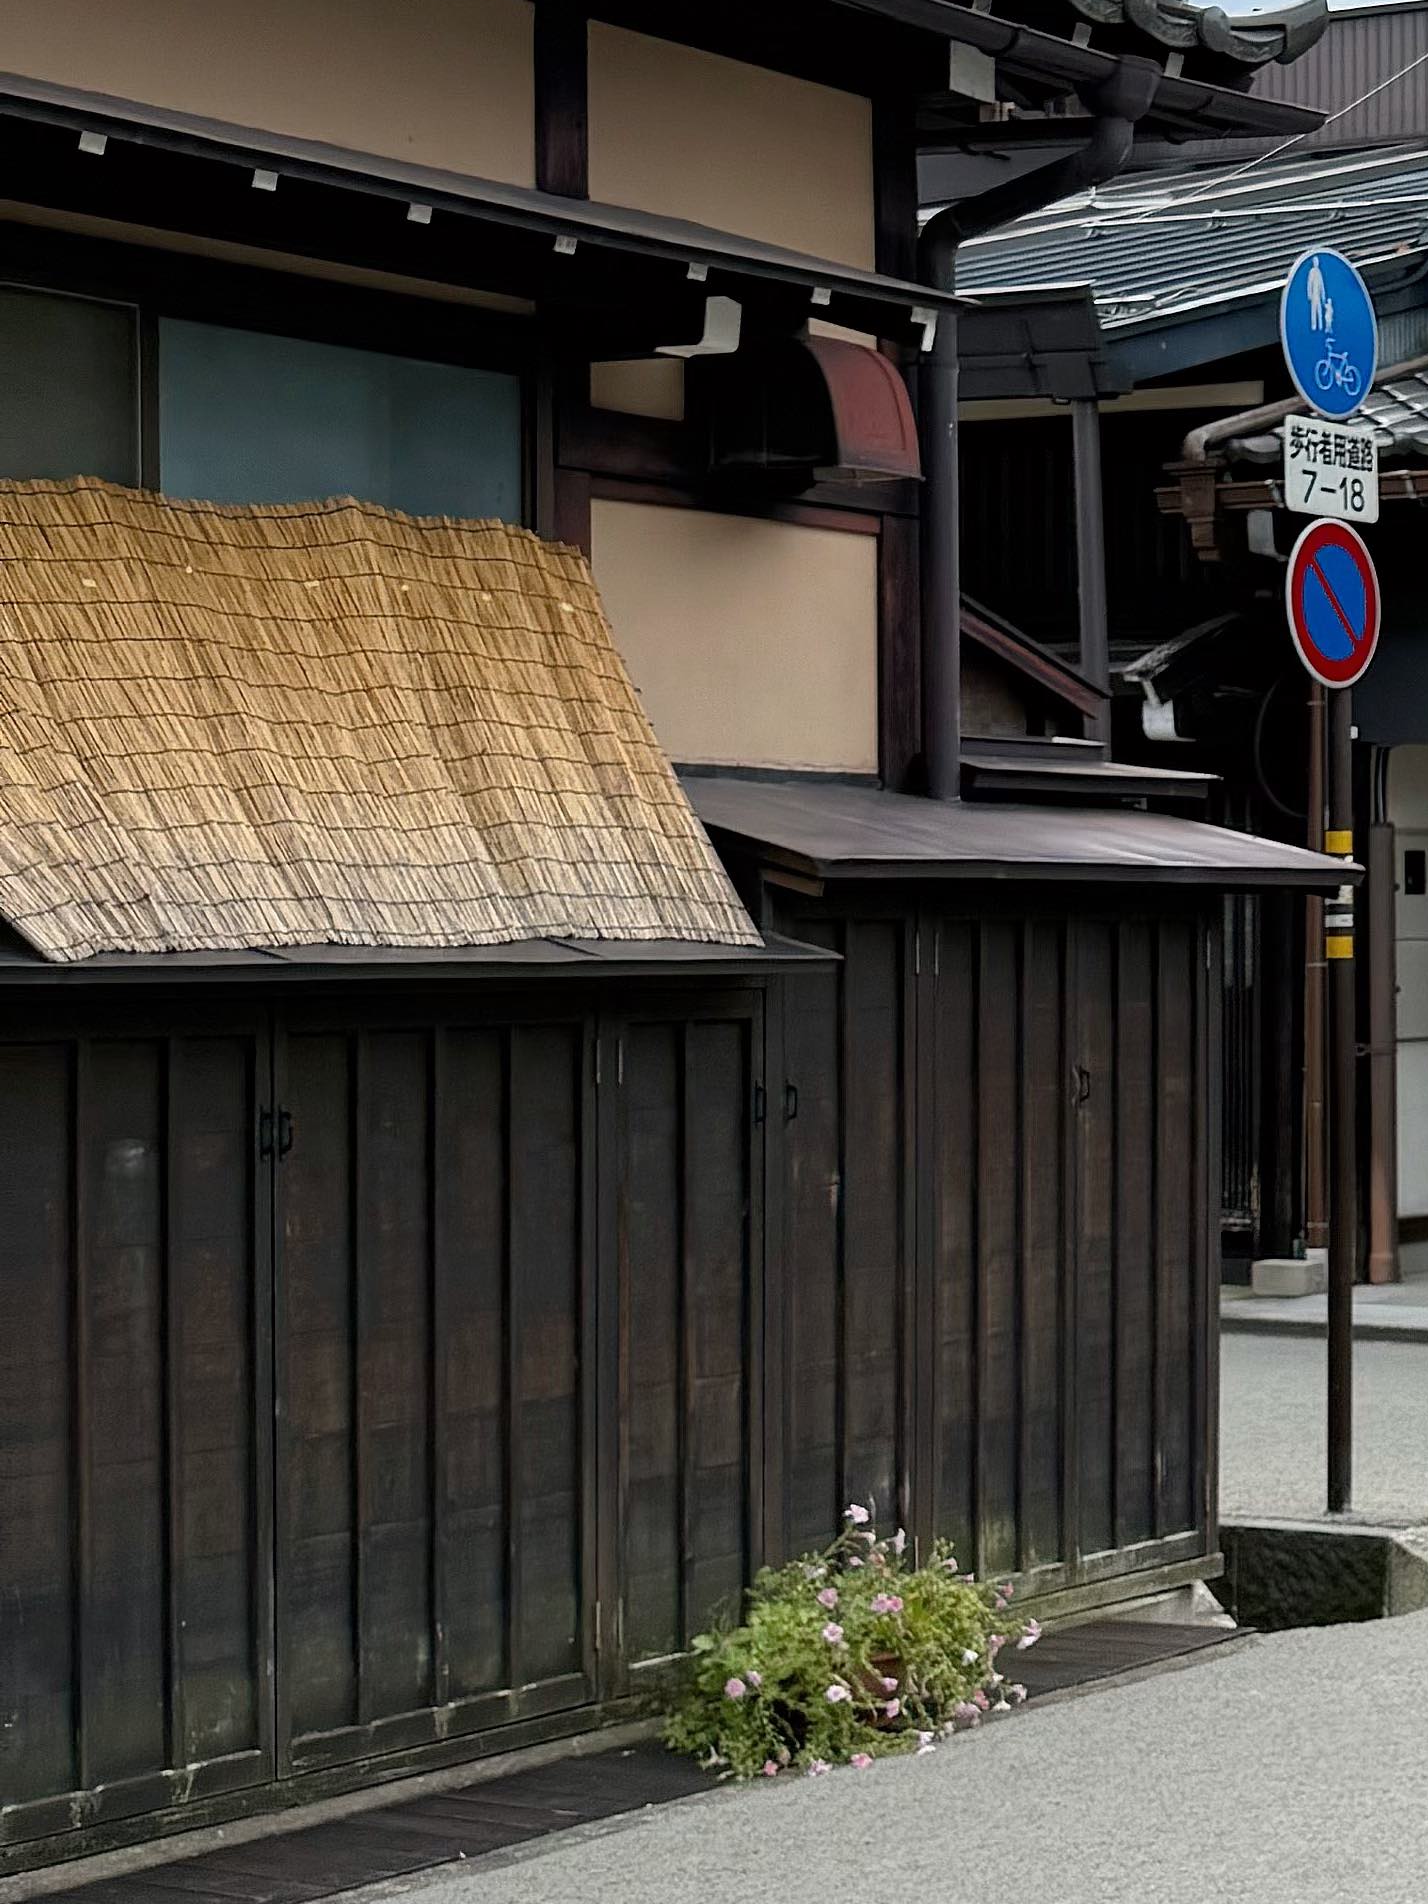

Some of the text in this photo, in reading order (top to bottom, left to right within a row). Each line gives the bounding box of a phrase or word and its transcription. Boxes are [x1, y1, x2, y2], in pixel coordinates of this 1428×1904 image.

[1290, 425, 1373, 472] 歩行者用道路
[1301, 469, 1365, 512] 7-18
